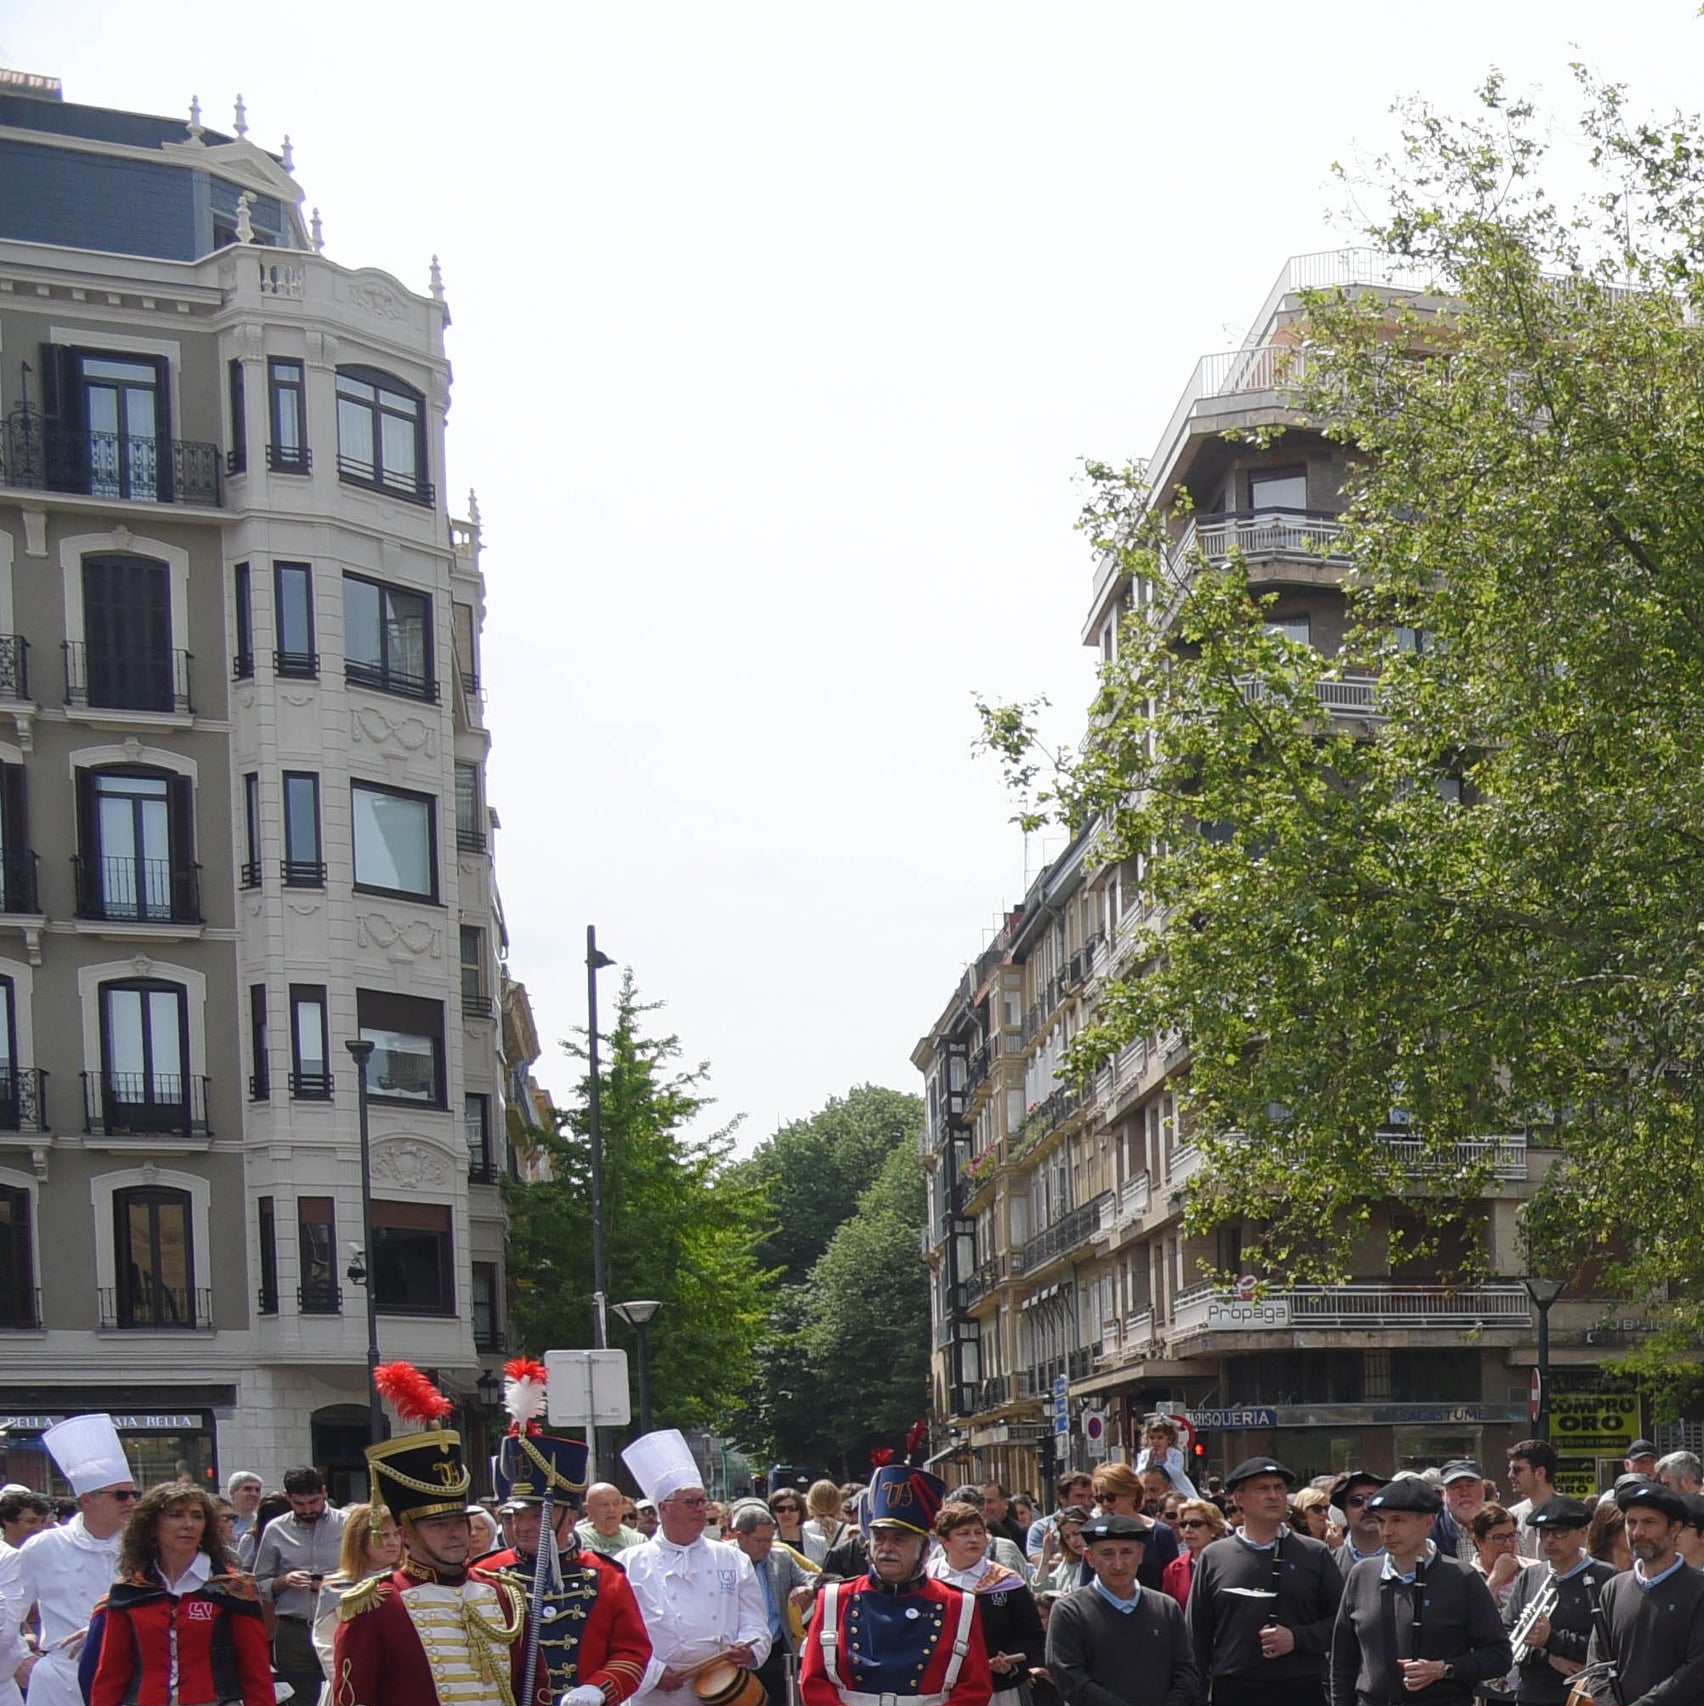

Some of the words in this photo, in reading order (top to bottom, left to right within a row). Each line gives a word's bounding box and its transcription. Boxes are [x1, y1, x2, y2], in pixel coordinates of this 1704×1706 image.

[1208, 1305, 1287, 1324] Propaga
[146, 1415, 193, 1427] BELLA
[1558, 1414, 1624, 1432] ORO
